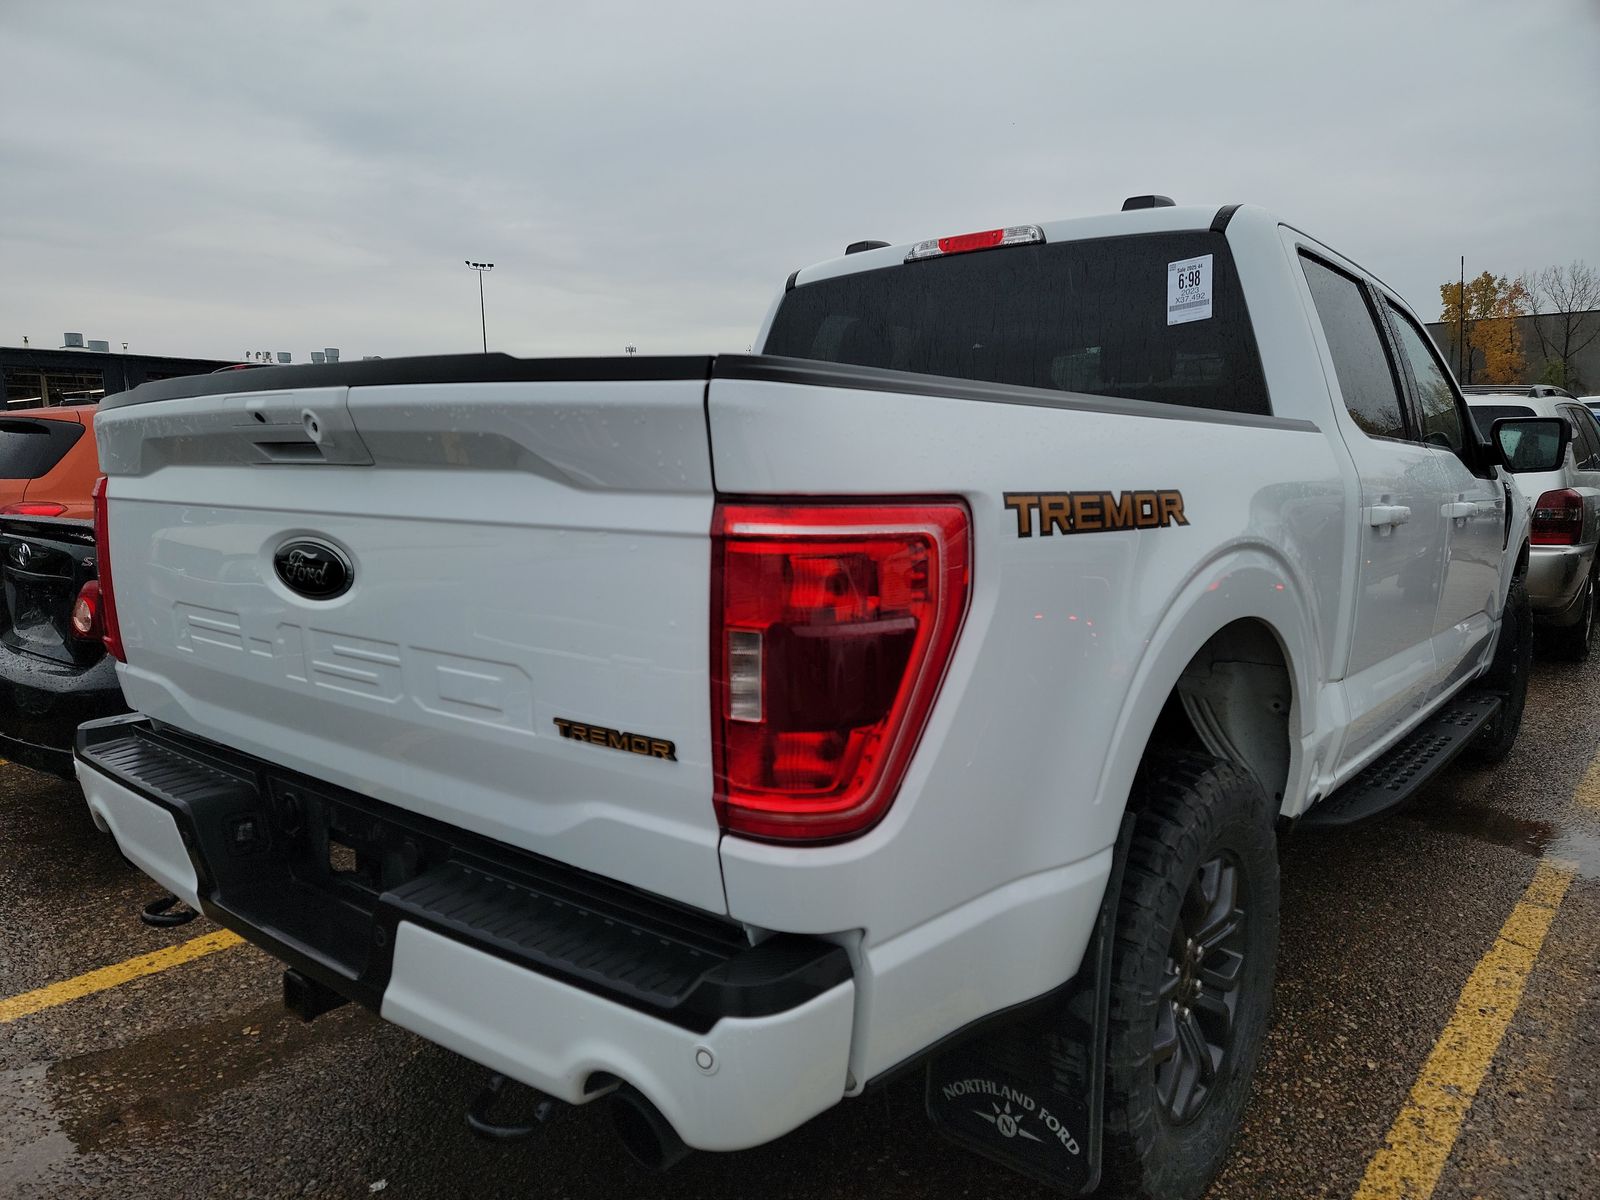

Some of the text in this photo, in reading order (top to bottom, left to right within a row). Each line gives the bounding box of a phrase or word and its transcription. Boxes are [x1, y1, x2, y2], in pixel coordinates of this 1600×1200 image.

[1178, 270, 1200, 289] 6:98
[1181, 287, 1199, 296] 2023
[1003, 489, 1191, 538] TREMOR
[281, 549, 328, 585] Ford
[553, 717, 678, 762] TREMOR
[942, 1079, 1080, 1155] NORTHLAND FORD
